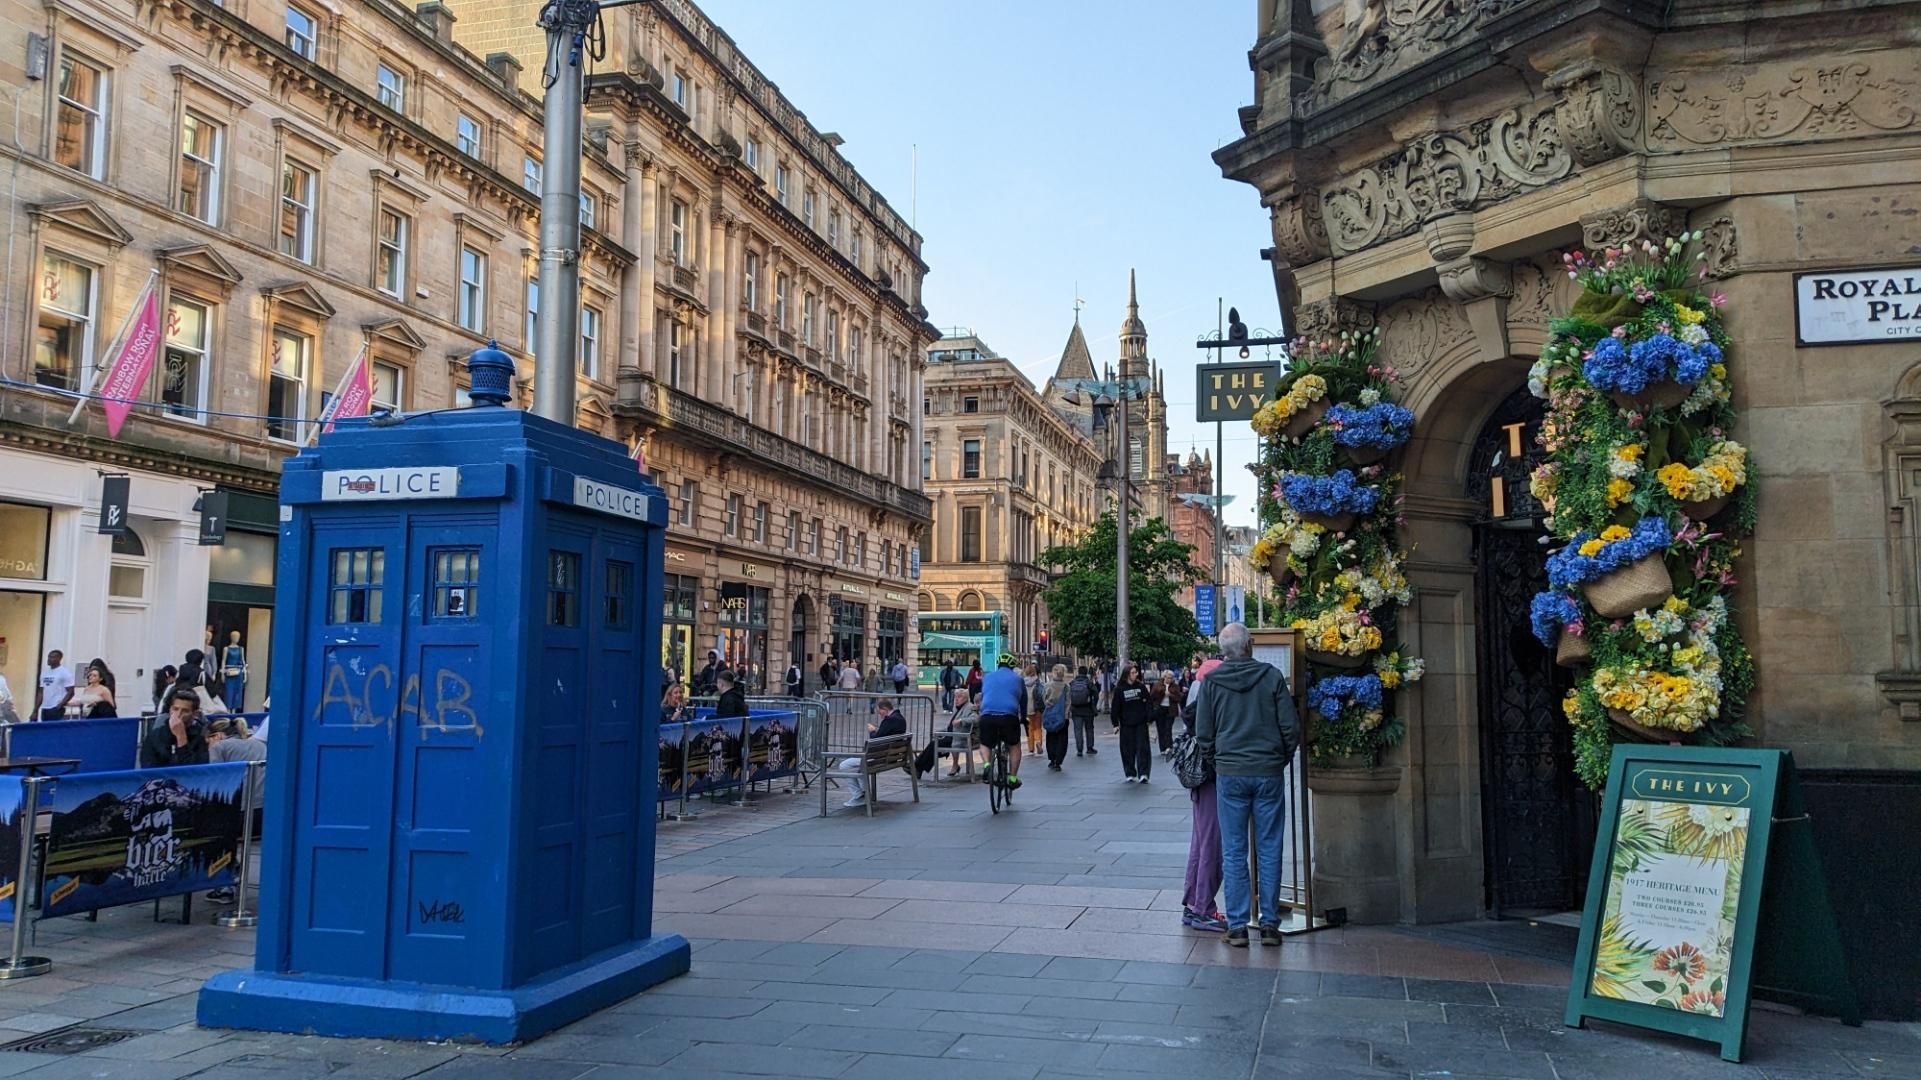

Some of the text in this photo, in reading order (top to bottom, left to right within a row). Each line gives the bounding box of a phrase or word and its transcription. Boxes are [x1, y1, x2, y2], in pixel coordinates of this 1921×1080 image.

[1813, 277, 1921, 300] ROYAL
[1886, 326, 1911, 335] CITY
[106, 353, 135, 400] RAINBOW
[131, 322, 149, 353] ROOM
[1211, 373, 1264, 389] THE
[1211, 394, 1264, 410] IVY
[338, 473, 441, 495] POLICE
[586, 485, 641, 516] POLICE
[312, 663, 484, 740] ACAB
[1649, 778, 1733, 795] THE IVY
[1626, 878, 1720, 897] 1917 HERITAGE MENU
[1655, 903, 1685, 913] COURSES
